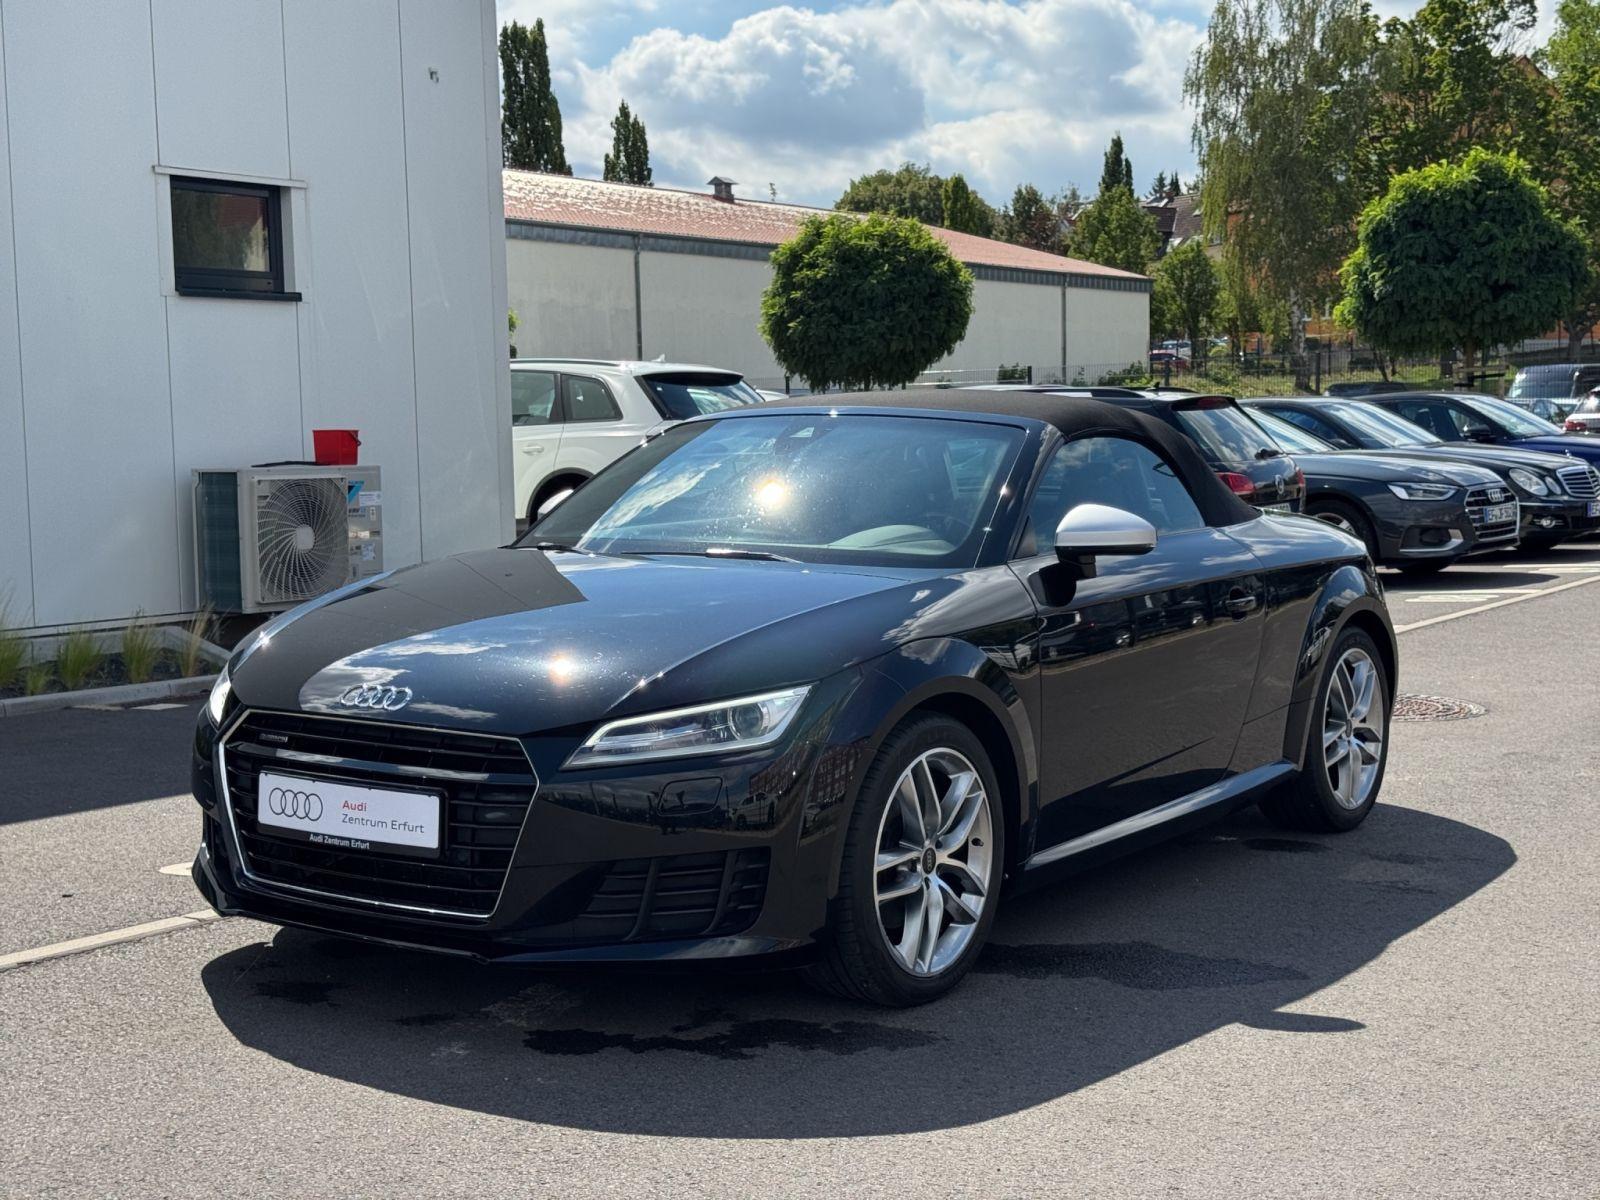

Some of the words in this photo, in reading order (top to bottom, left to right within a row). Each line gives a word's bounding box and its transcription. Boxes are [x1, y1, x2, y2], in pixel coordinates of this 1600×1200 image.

[342, 800, 367, 812] Audi
[341, 813, 388, 829] Zentrum
[391, 820, 425, 834] Erfurt
[309, 834, 323, 843] Audi
[324, 836, 350, 847] Zentrum
[351, 839, 370, 850] Erfurt
